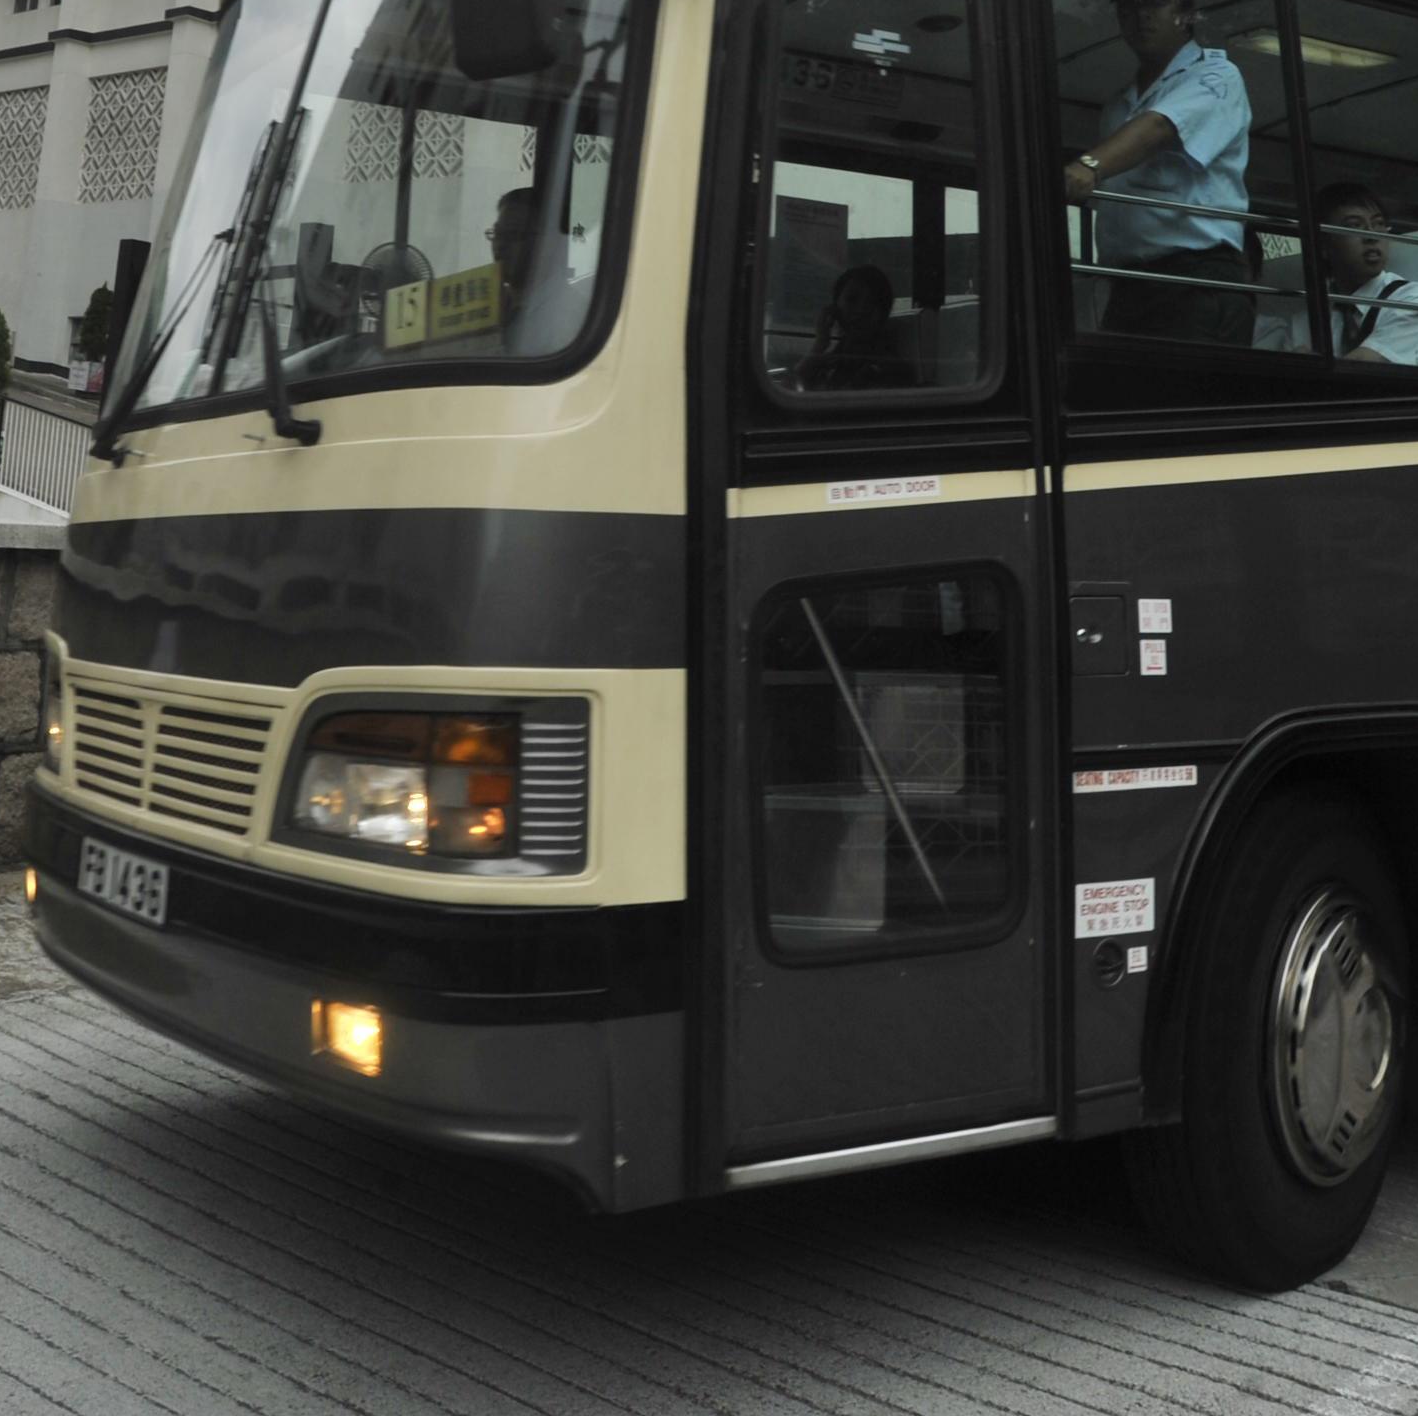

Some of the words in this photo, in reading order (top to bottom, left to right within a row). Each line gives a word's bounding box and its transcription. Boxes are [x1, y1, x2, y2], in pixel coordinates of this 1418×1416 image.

[1083, 884, 1147, 900] EMERGENCY
[1081, 901, 1120, 916] ENGINE
[1124, 898, 1149, 913] STOP
